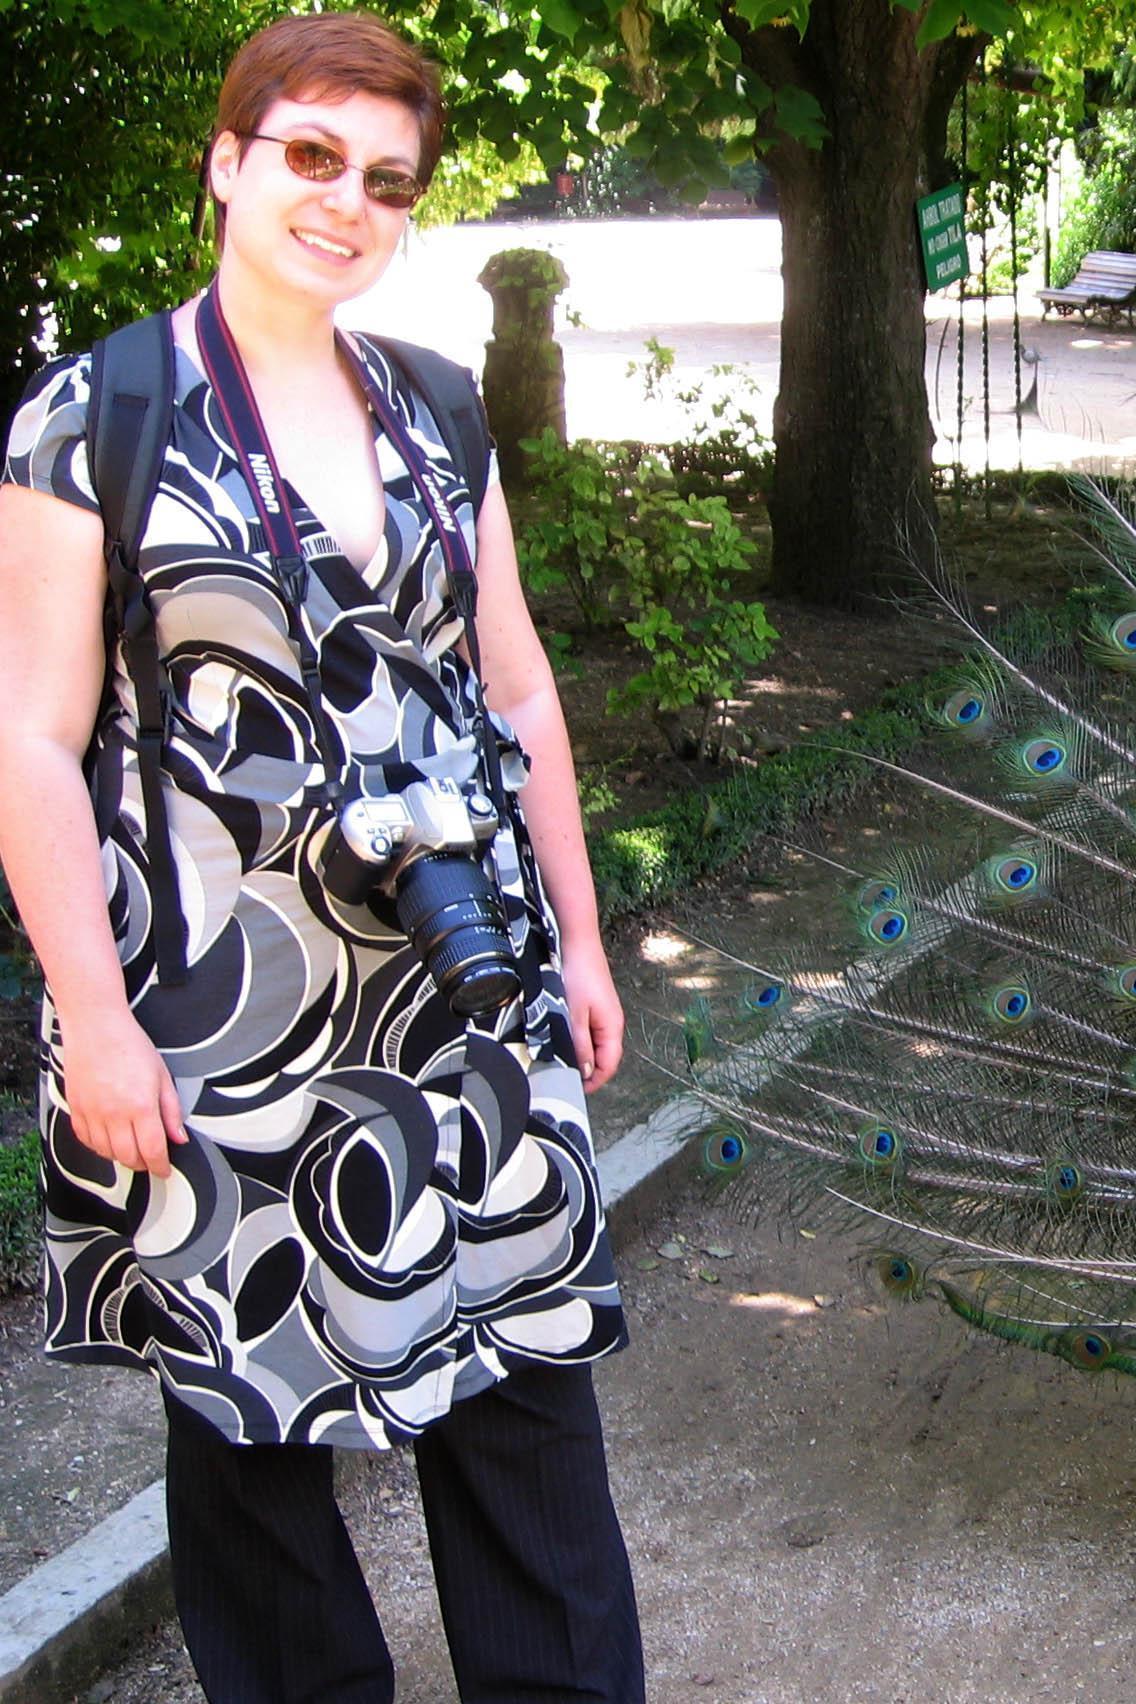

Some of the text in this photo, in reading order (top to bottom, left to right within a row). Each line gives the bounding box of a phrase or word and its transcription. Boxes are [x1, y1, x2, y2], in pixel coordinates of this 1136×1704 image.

[936, 253, 961, 279] PELIGRO
[247, 453, 281, 514] Nikon
[421, 473, 457, 532] Nikon
